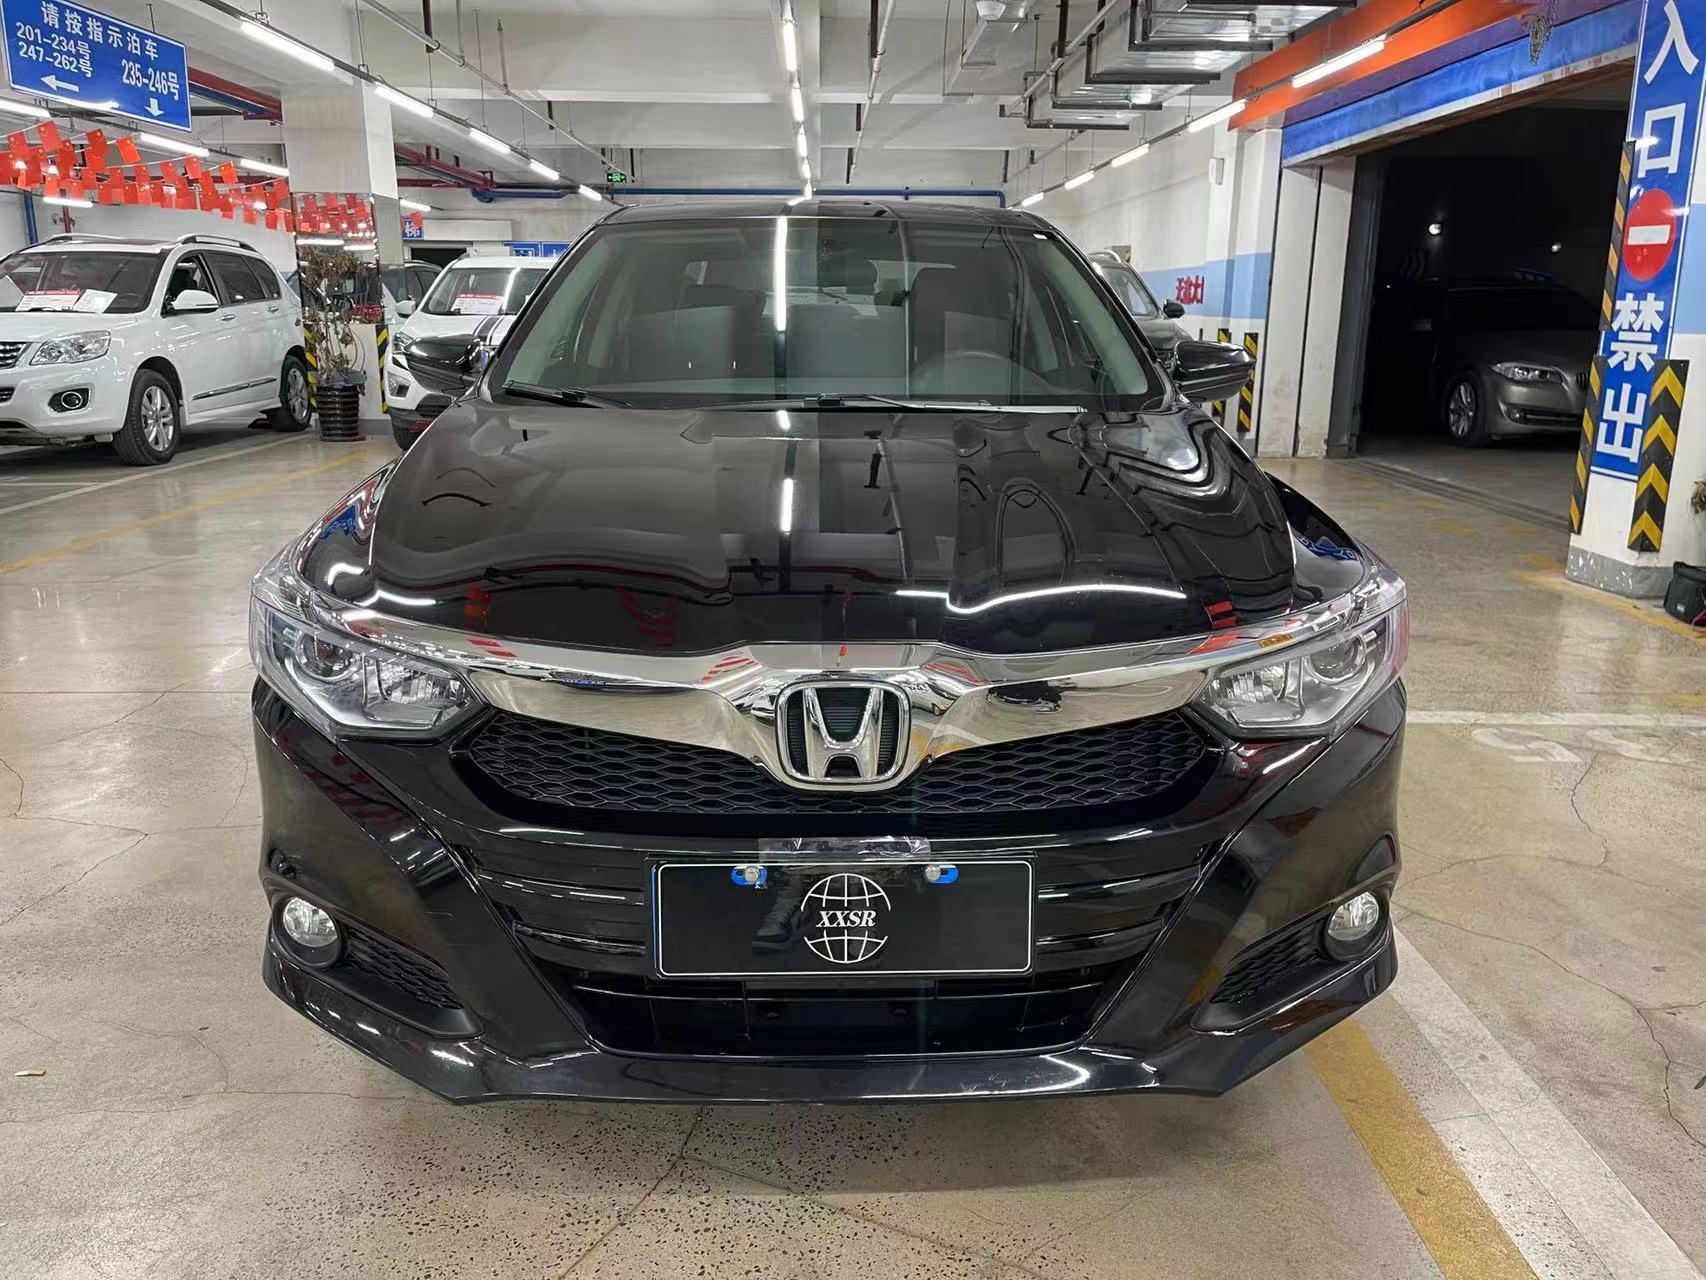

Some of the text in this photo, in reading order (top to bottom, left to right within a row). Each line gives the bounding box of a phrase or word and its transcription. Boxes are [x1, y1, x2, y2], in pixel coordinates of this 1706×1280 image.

[16, 22, 91, 60] 201-234号
[41, 2, 159, 60] 请按指示泊车
[18, 42, 93, 78] 247-262号
[121, 58, 180, 101] 235-246号
[1637, 0, 1700, 179] 入口
[1596, 292, 1664, 463] 禁出
[815, 910, 877, 928] XXSR
